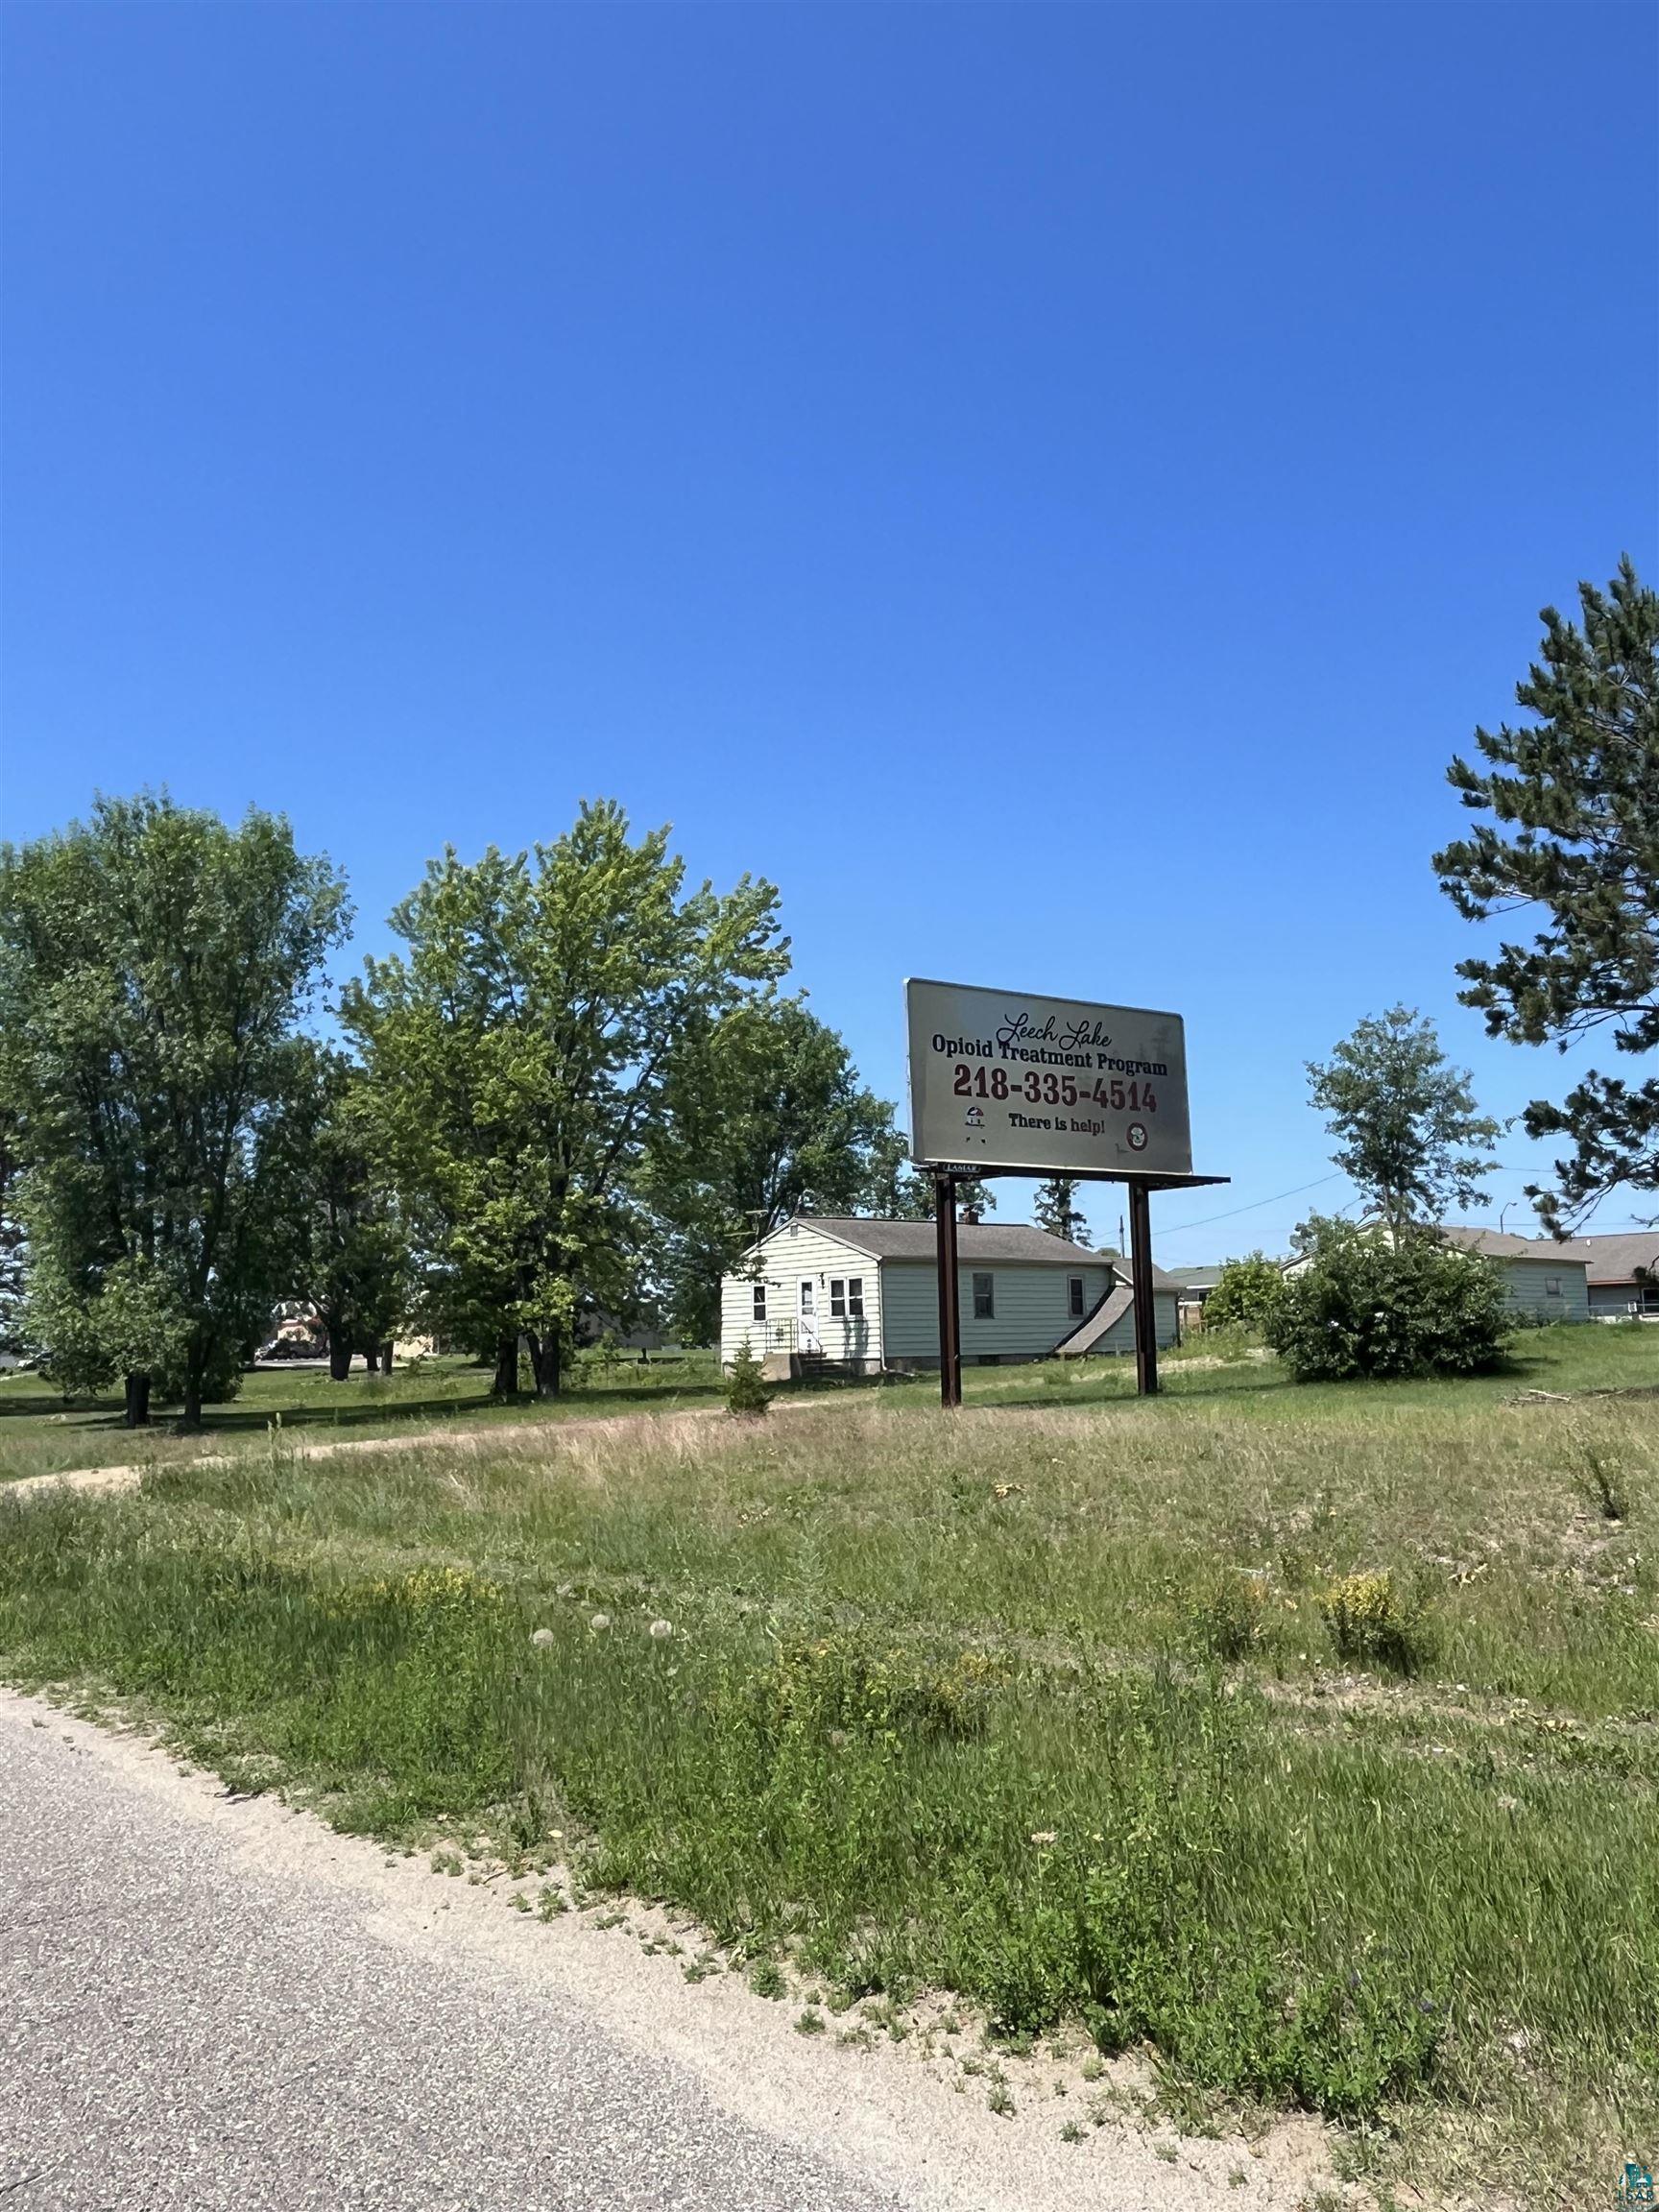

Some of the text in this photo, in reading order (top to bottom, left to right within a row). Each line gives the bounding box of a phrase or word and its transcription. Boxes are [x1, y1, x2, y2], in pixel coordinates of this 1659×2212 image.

[996, 1013, 1113, 1051] Leech Lake
[932, 1034, 1168, 1077] Opioid Treatment Program
[953, 1064, 1157, 1114] 218-335-4514
[1008, 1113, 1105, 1137] There is help!
